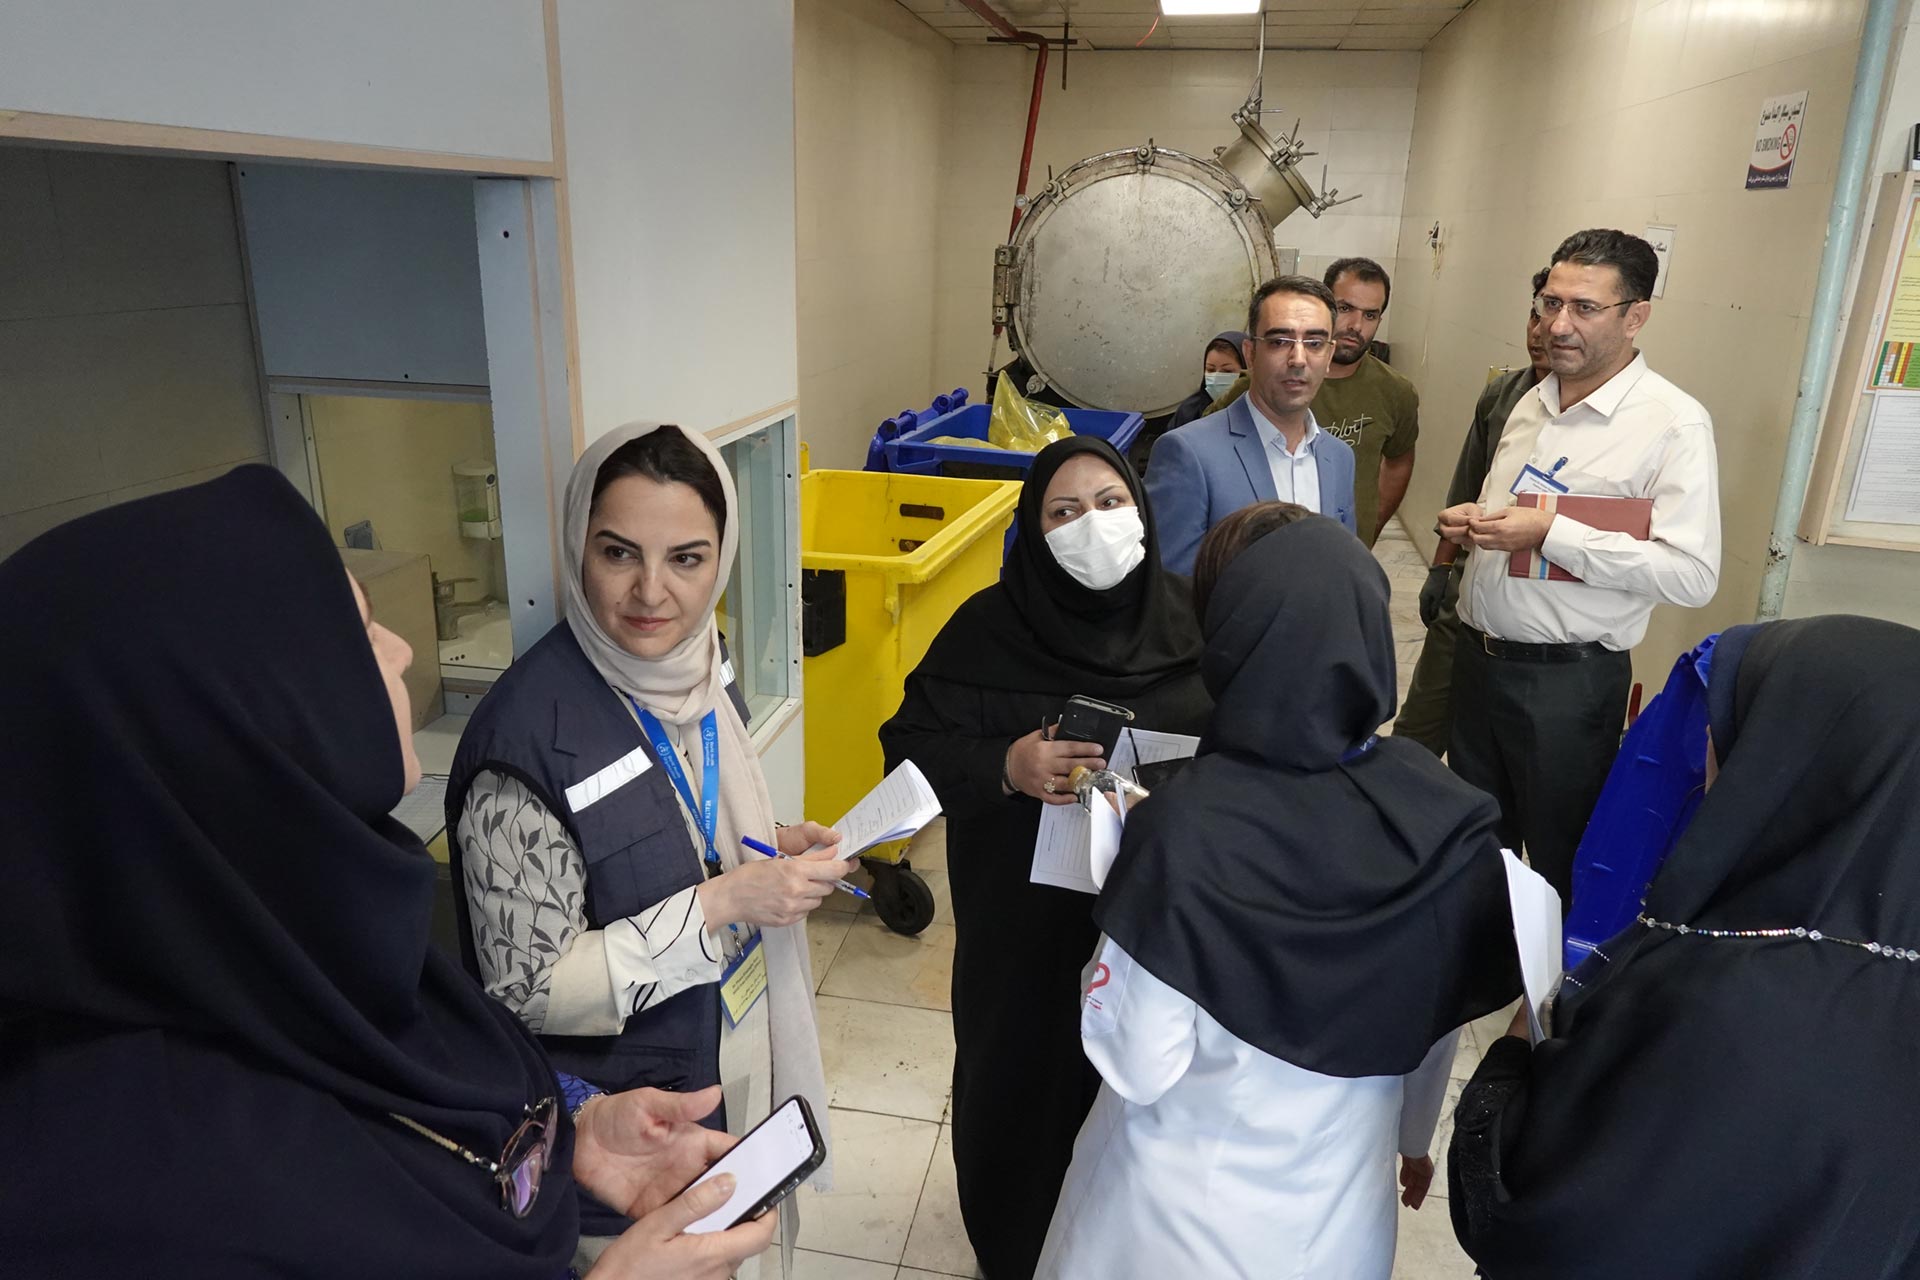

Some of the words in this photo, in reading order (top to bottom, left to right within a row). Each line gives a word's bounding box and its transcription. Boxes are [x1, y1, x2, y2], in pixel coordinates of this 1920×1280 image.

[1755, 138, 1763, 152] NO
[1761, 136, 1782, 152] SMOKING
[704, 799, 712, 820] HEALTH
